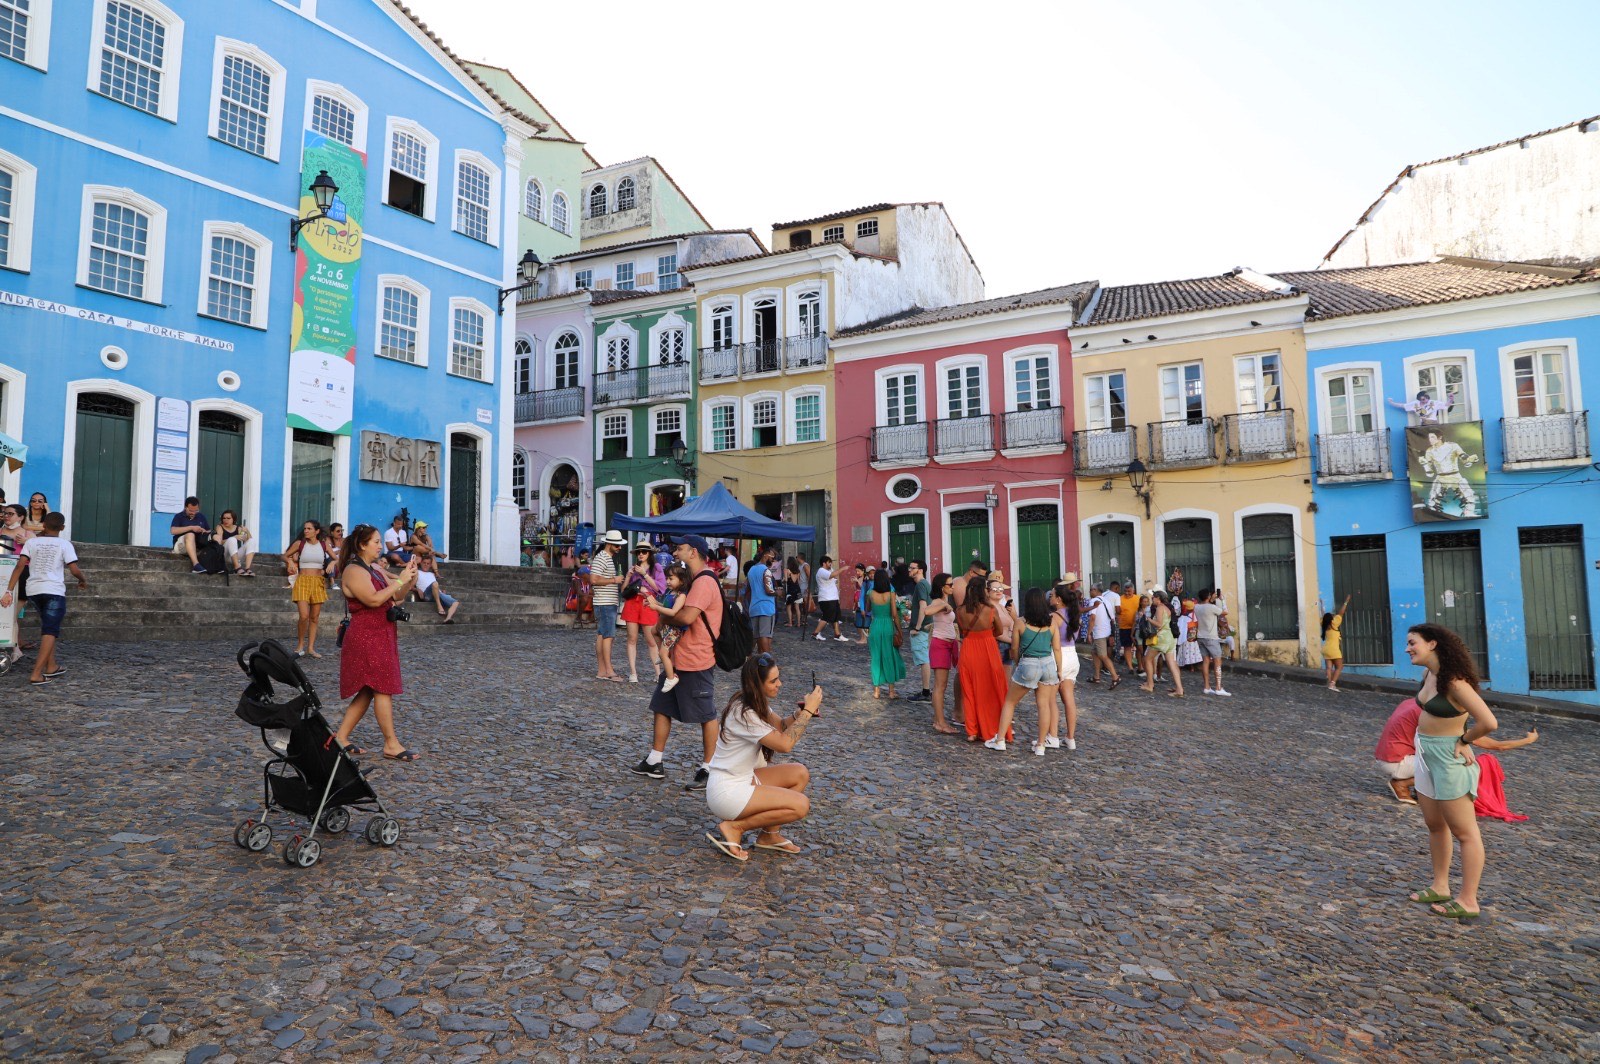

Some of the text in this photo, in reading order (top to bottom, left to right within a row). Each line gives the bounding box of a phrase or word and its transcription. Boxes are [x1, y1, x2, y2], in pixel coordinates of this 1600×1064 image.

[333, 243, 353, 255] 2022
[336, 269, 344, 281] 6
[309, 274, 349, 291] de NOVEMBRO
[78, 309, 115, 326] CASA
[144, 324, 186, 341] JORGE
[194, 334, 233, 352] AMADO
